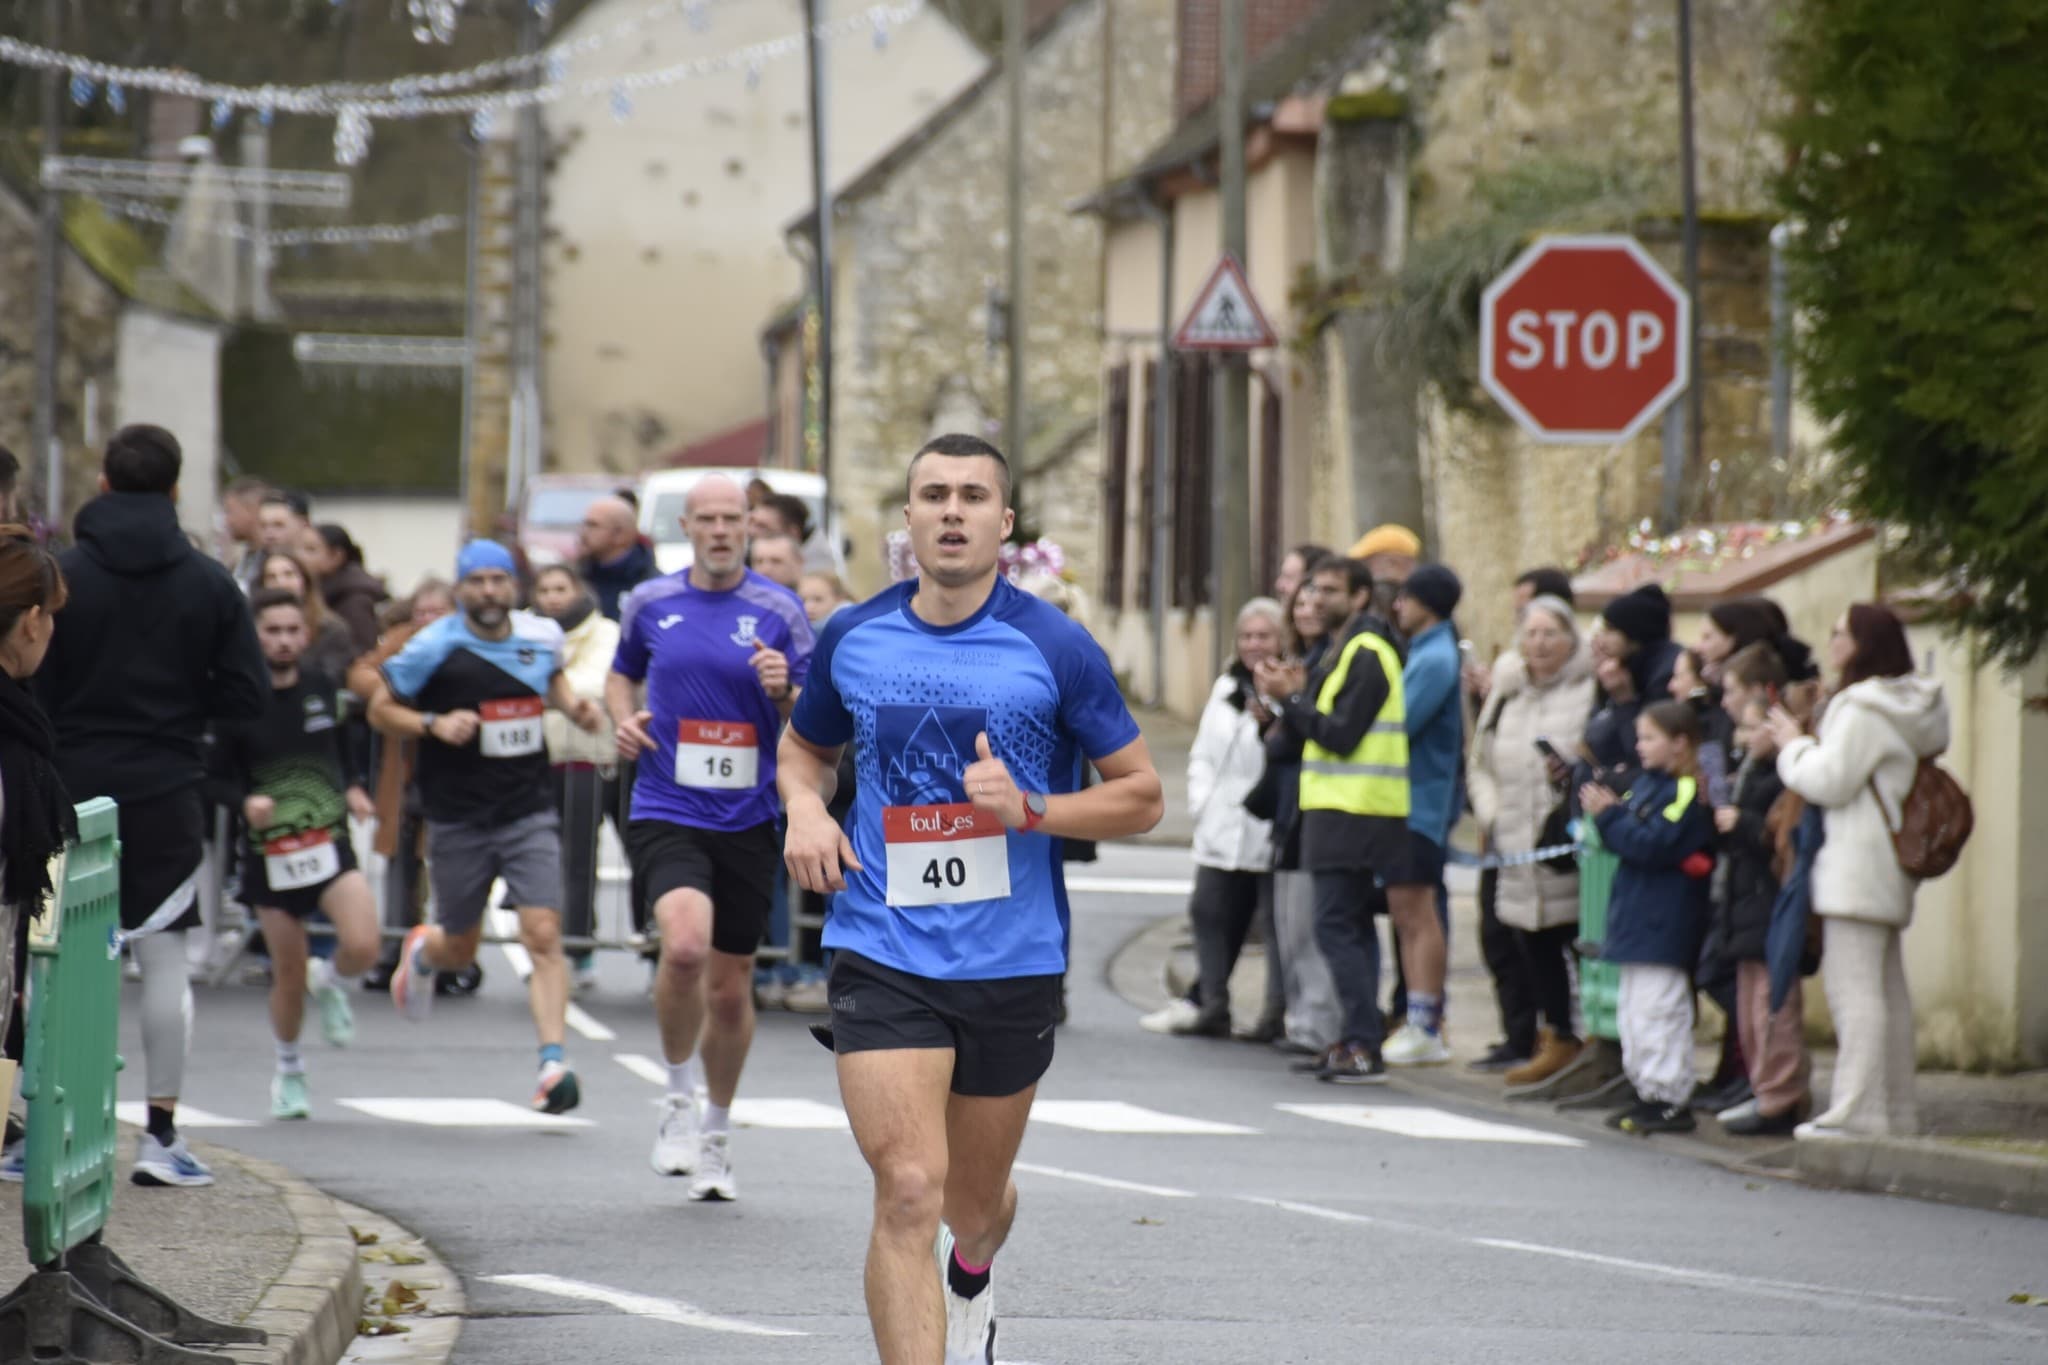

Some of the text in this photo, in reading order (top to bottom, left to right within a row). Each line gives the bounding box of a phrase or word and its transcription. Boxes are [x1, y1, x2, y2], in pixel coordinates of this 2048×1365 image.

[1507, 310, 1664, 369] STOP
[704, 757, 733, 778] 16
[922, 857, 966, 888] 40
